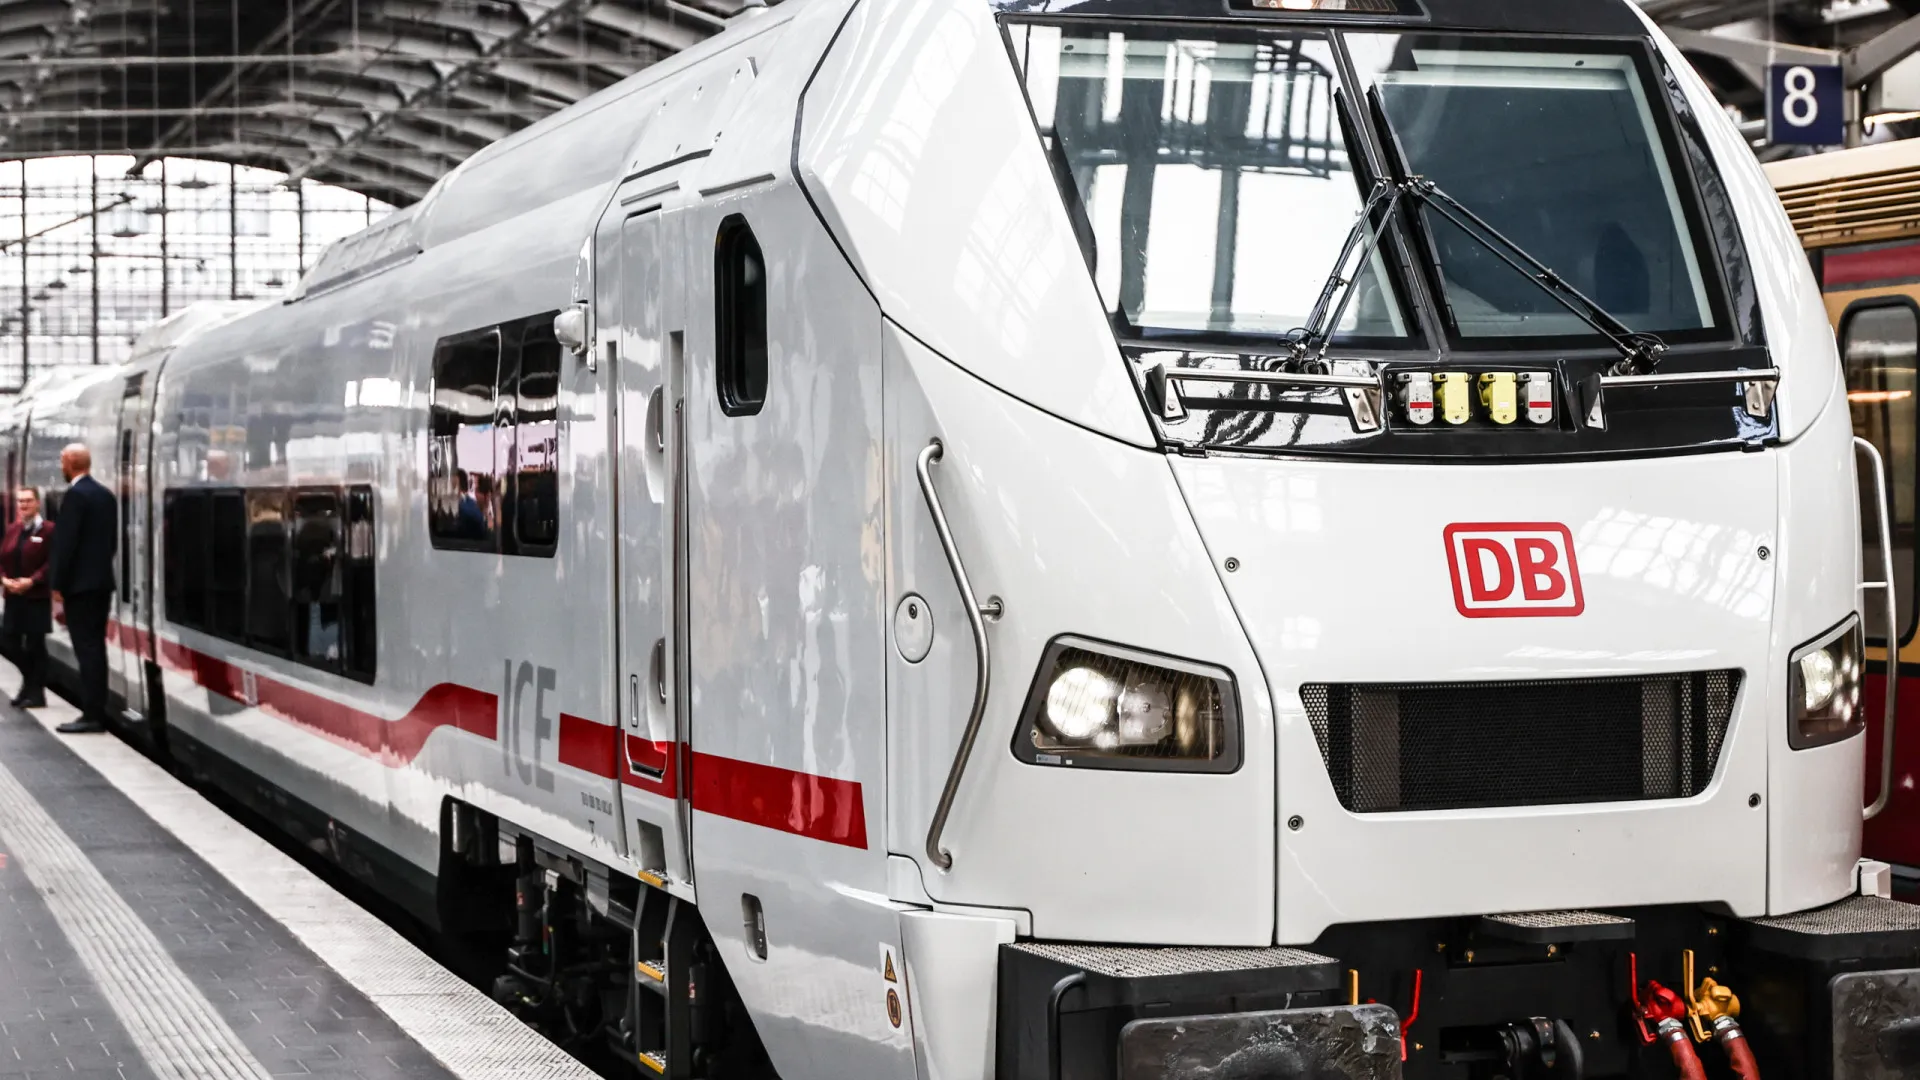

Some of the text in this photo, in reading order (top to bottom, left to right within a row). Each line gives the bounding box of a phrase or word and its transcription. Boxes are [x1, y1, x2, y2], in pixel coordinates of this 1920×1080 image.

[1782, 66, 1818, 127] 8
[1462, 538, 1566, 602] DB
[503, 659, 556, 793] ICE
